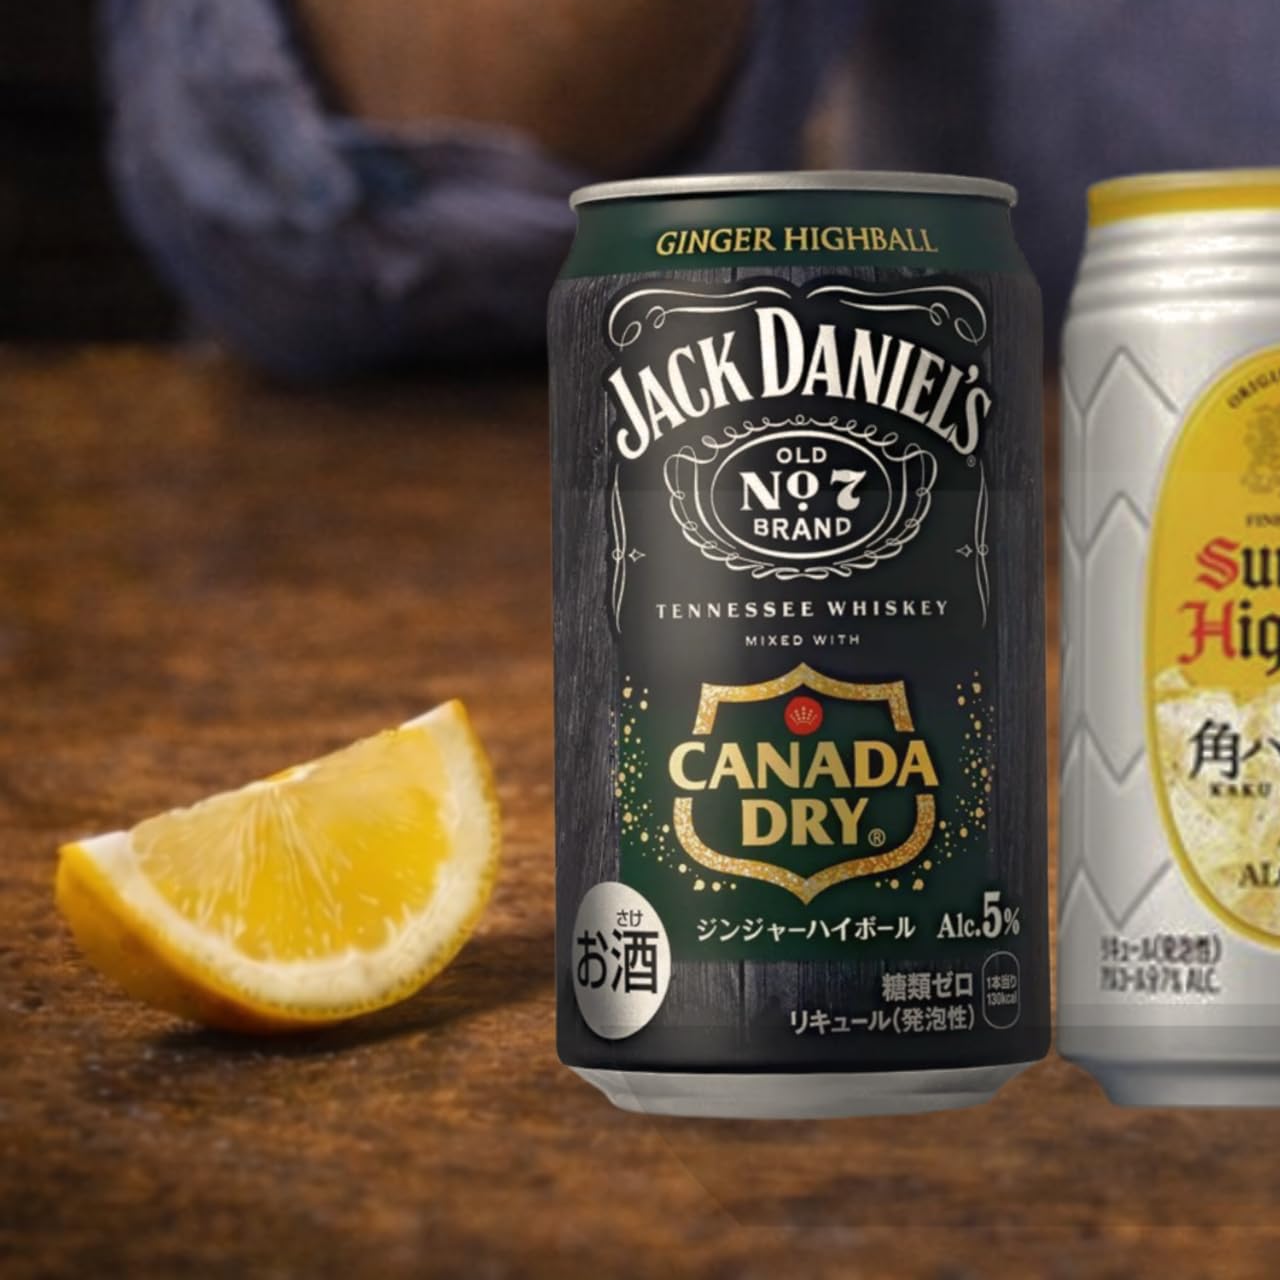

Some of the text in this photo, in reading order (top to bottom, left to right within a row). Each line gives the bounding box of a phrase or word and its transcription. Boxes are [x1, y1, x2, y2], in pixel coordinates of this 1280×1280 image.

[656, 227, 938, 257] GINGER HIGHBALL
[609, 306, 992, 460] JACK DANIEL'S
[776, 447, 827, 464] OLD
[830, 469, 867, 511] 7
[754, 517, 852, 541] BRAND
[656, 599, 948, 619] TENNESSEE WHISKEY
[745, 634, 860, 647] MIXED WITH
[668, 739, 939, 790] CANADA
[1210, 783, 1272, 797] KAKU
[617, 909, 643, 927] さけ
[696, 916, 916, 942] ジンジャーハイボール
[577, 928, 659, 993] お酒
[881, 972, 974, 1002] 糖類ゼロ
